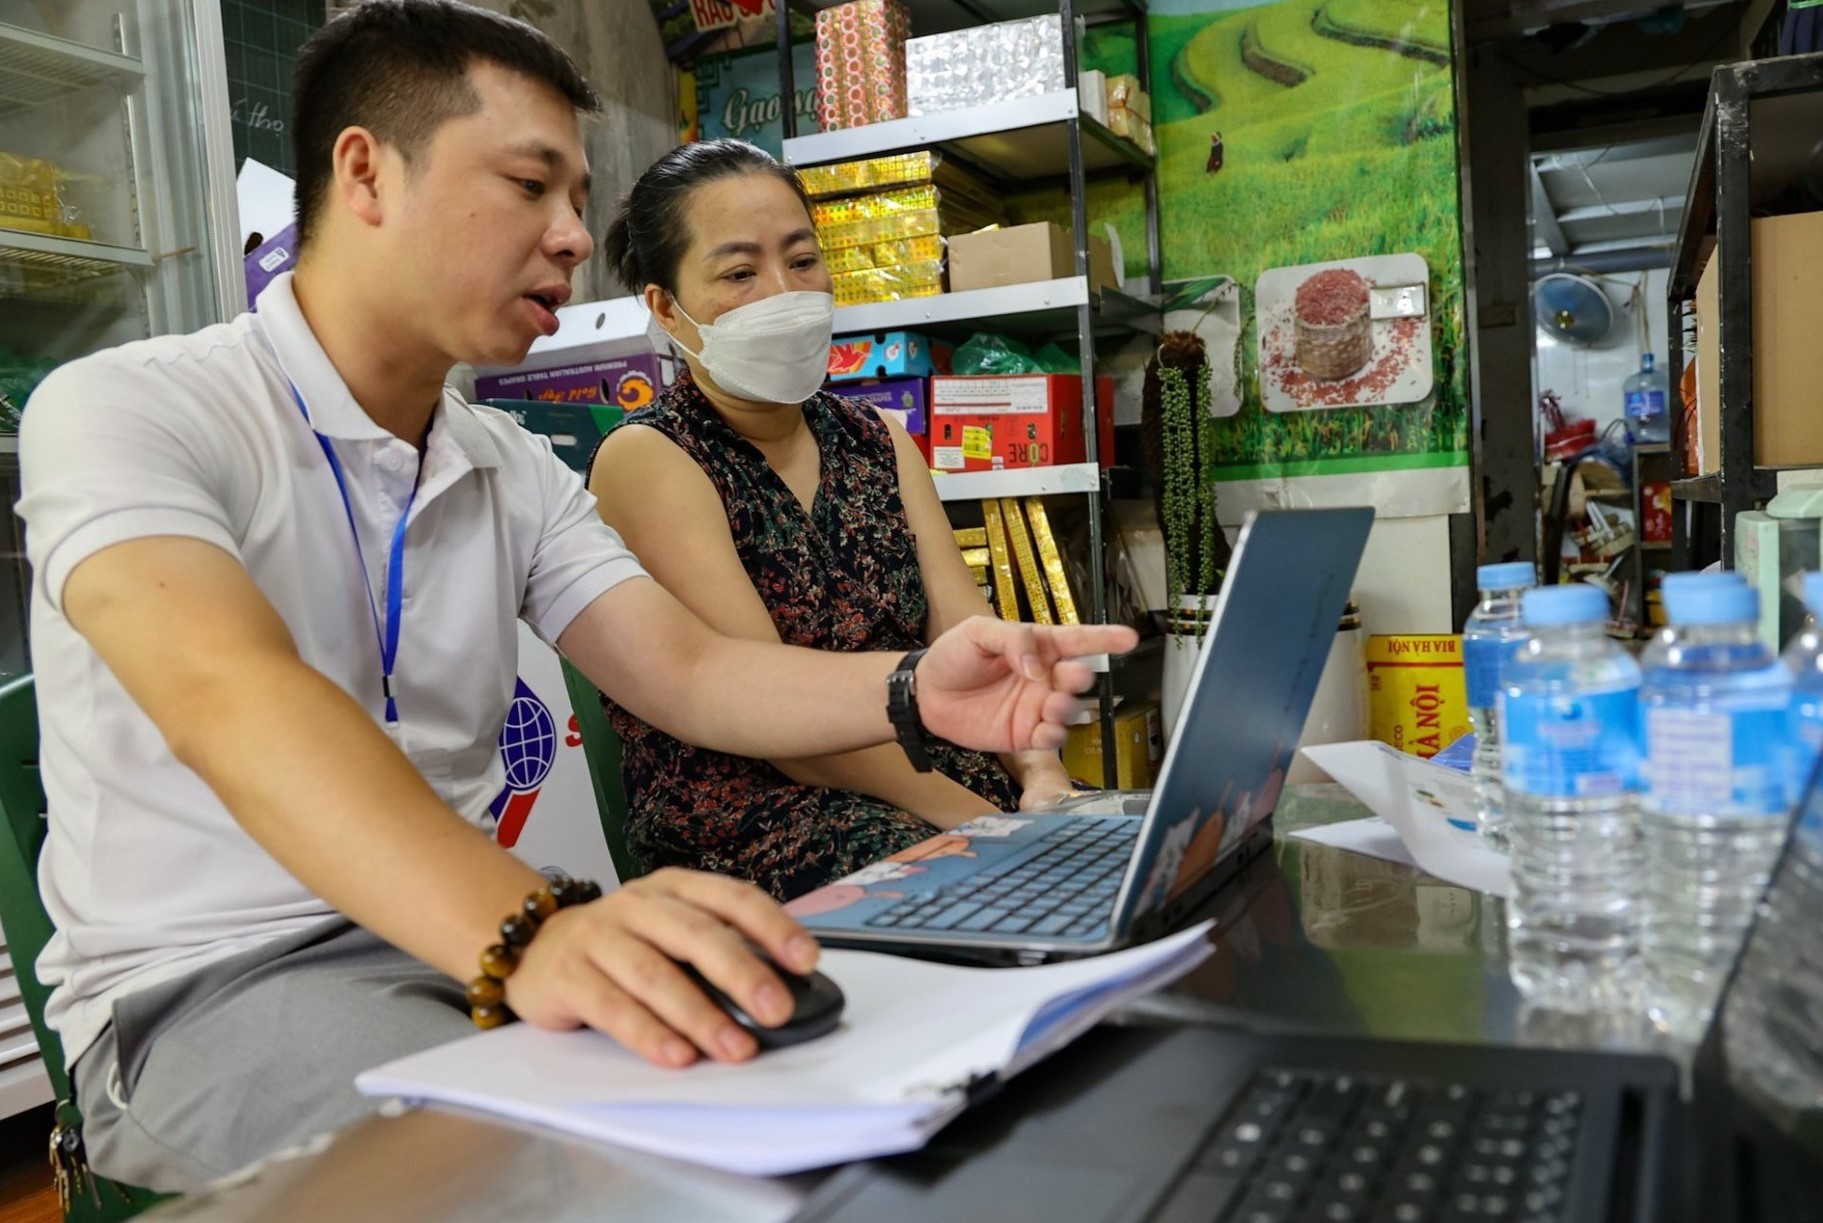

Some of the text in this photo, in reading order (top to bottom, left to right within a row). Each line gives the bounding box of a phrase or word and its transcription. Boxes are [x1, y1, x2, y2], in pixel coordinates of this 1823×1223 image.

[722, 89, 781, 136] Gạo
[498, 361, 628, 386] PREMIUM AUSTRALIAN TABLE GRAPES
[1008, 443, 1049, 466] CORE
[1387, 639, 1455, 656] BIA HÀ NỘI
[1409, 684, 1446, 729] NỘI
[1394, 725, 1403, 751] ECO
